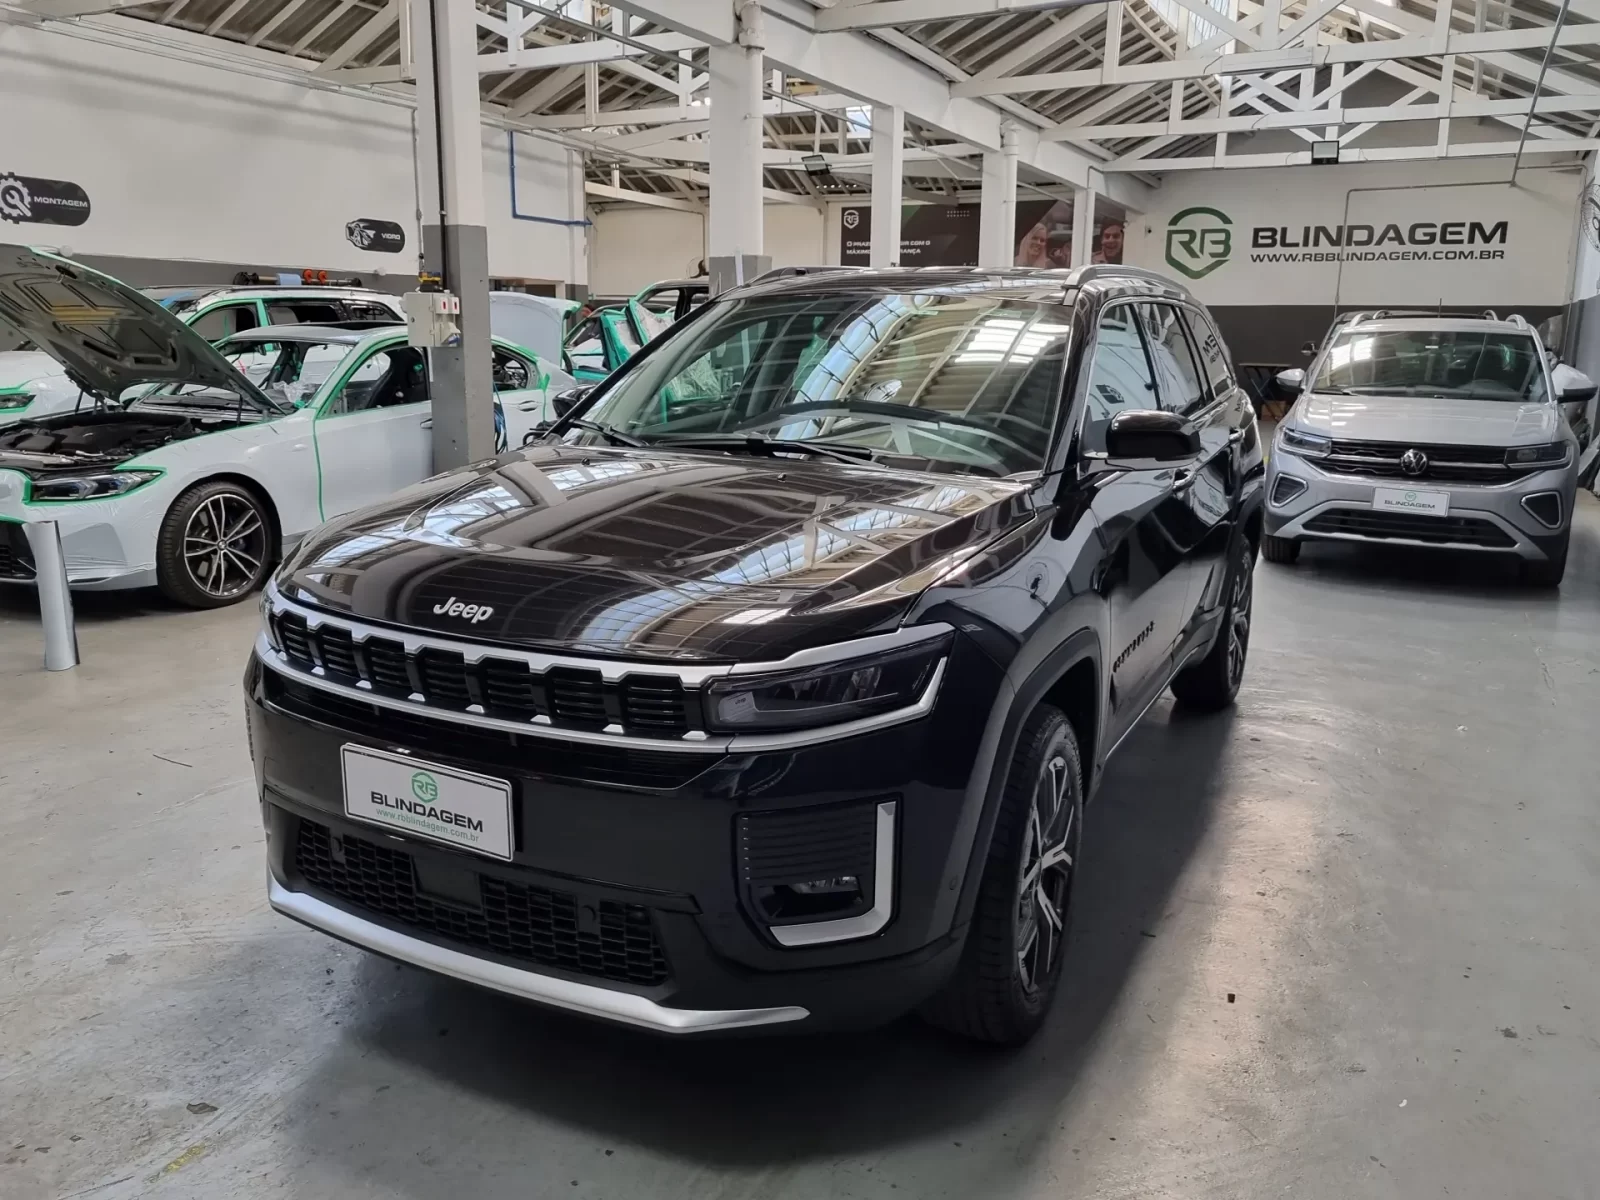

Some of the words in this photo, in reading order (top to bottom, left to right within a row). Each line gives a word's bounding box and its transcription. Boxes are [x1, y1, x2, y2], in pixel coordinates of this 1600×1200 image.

[33, 196, 89, 208] MONTAGEM
[1252, 221, 1509, 249] BLINDAGEM
[1250, 250, 1505, 263] WWW.RBBLINDAGEM.COM.BR
[1384, 499, 1436, 509] BLINDAGEM
[433, 596, 495, 624] Jeep
[370, 791, 484, 833] BLINDAGEM
[375, 807, 480, 843] www.rbblindagem.com.br
